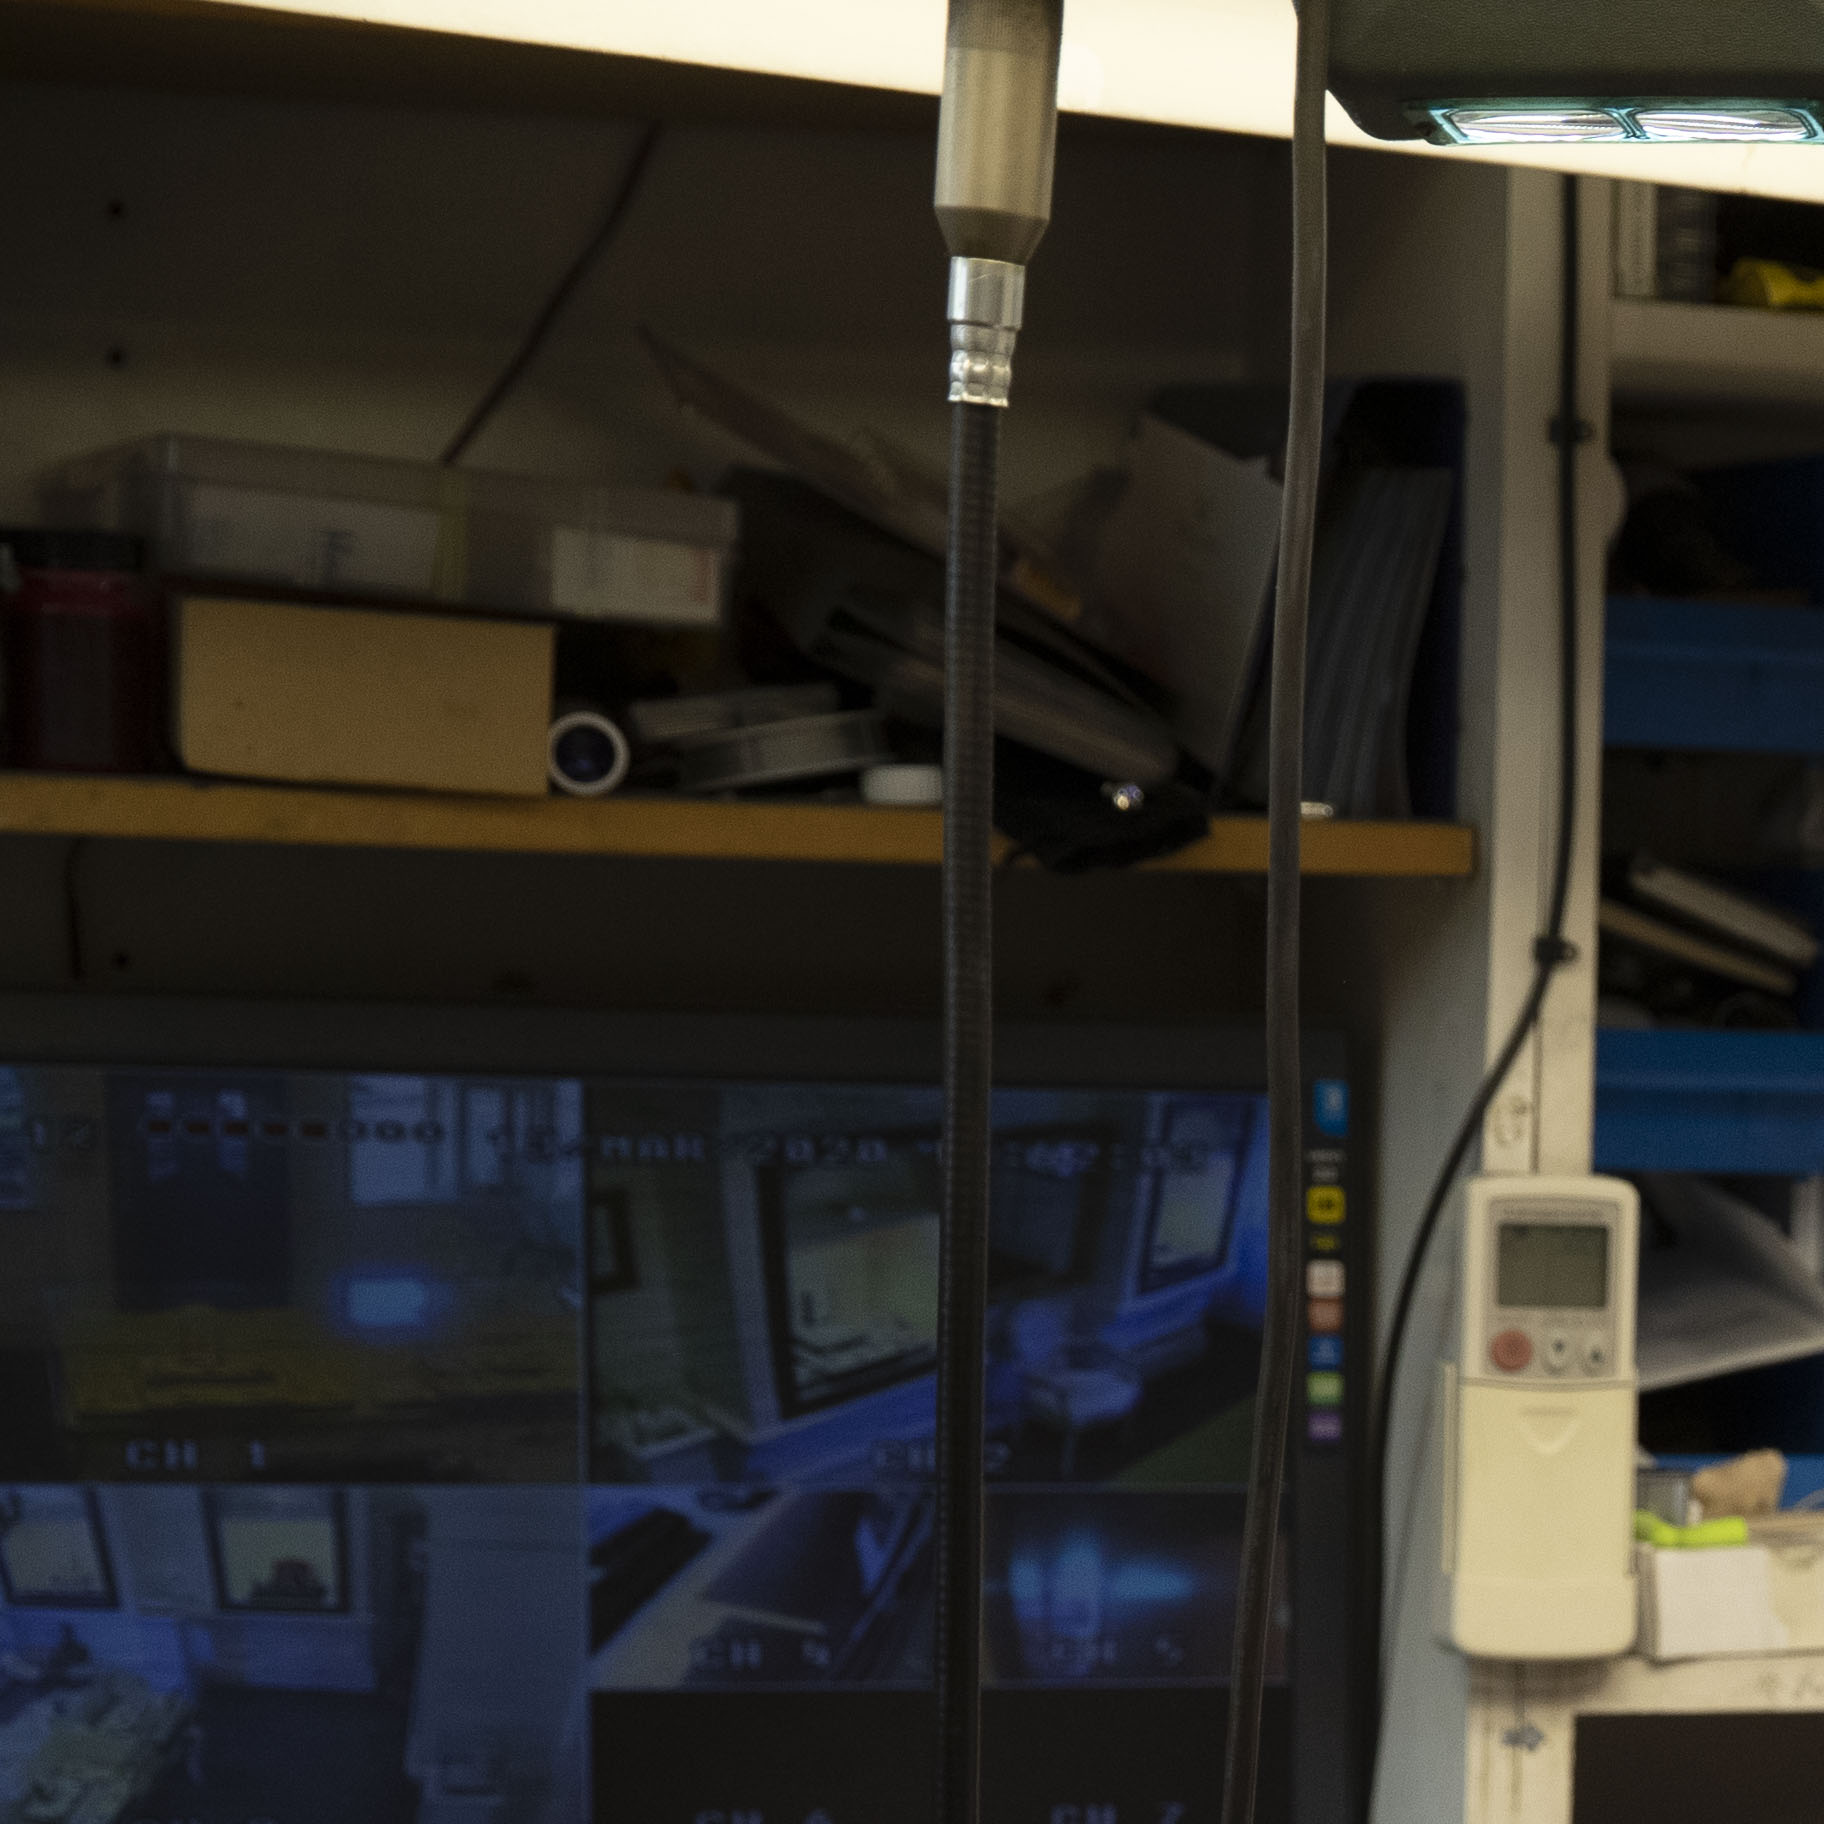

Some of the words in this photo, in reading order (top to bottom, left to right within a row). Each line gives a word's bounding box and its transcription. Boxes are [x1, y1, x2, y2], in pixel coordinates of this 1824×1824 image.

[125, 1438, 198, 1471] CH
[250, 1439, 266, 1471] 1
[689, 1639, 762, 1671] CH
